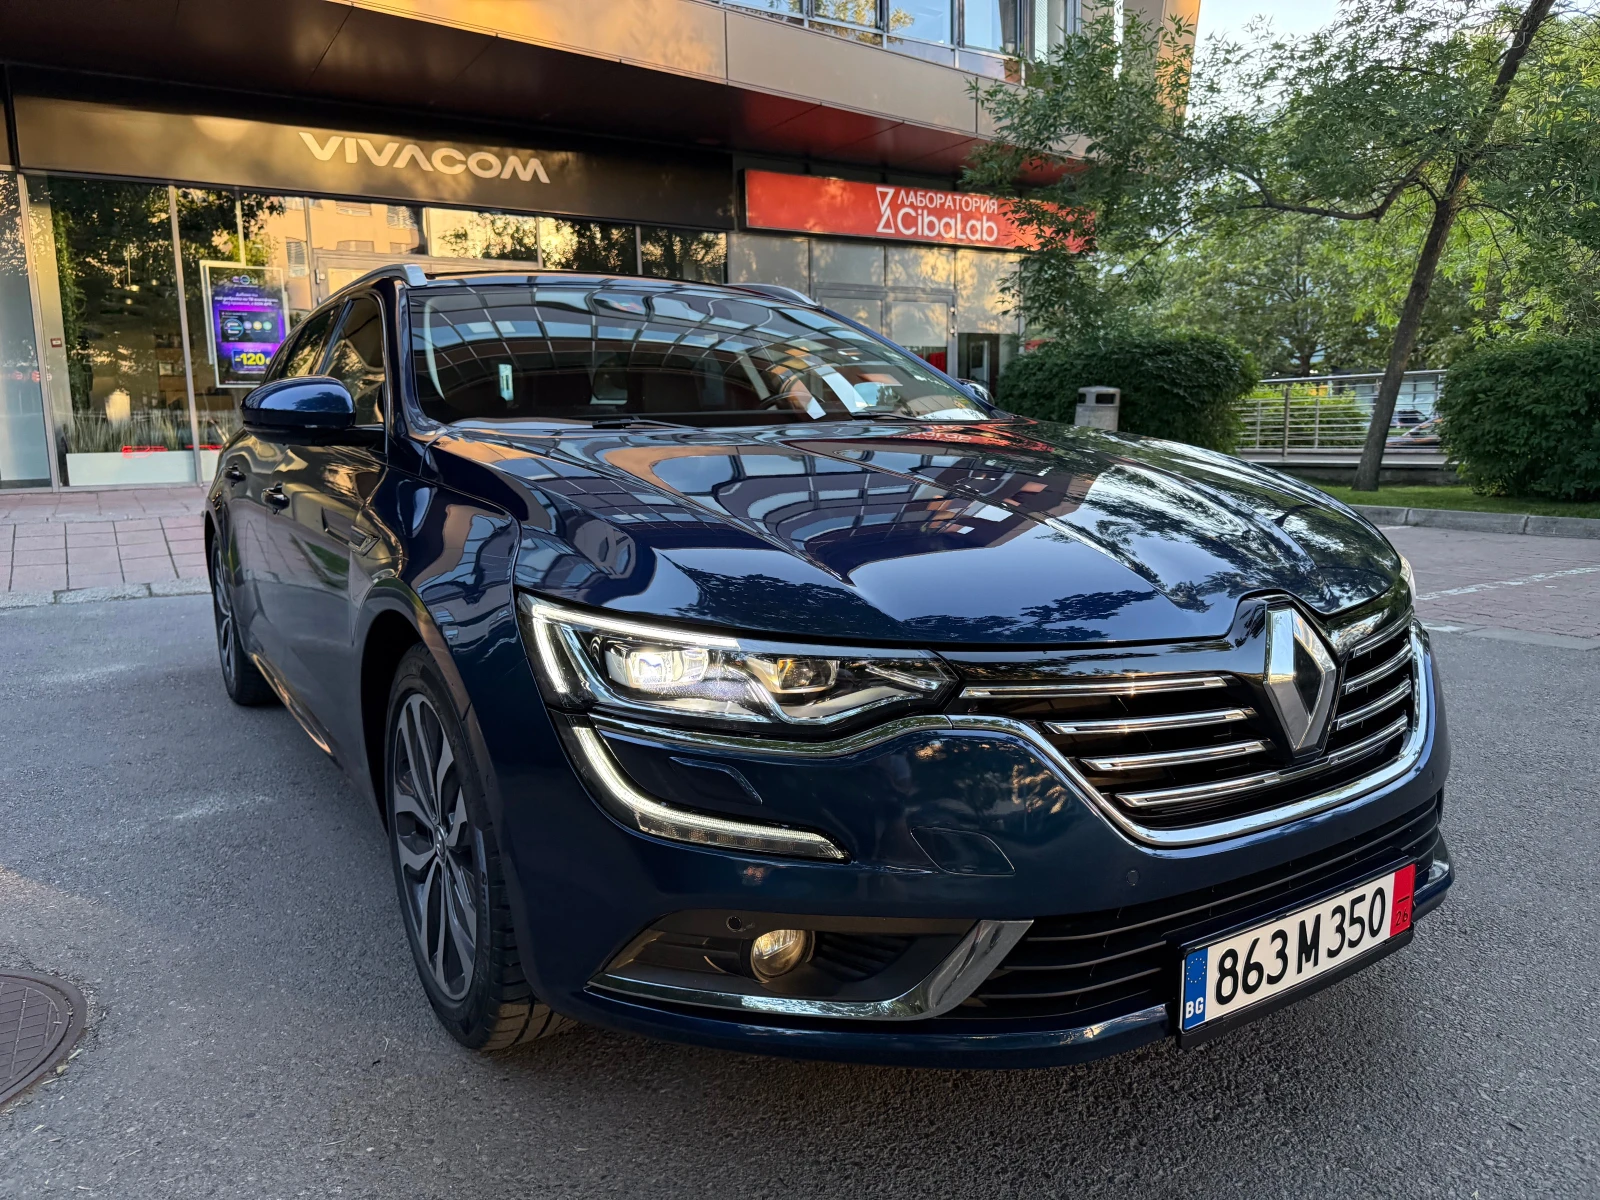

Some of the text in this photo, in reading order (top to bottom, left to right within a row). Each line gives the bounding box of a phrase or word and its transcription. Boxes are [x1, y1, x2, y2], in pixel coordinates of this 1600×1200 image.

[299, 132, 550, 184] VIVACOM
[897, 190, 998, 214] ЛАБОРАТОРИЯ
[897, 207, 998, 242] CibaLab
[1395, 908, 1409, 927] 26
[1215, 929, 1288, 1006] 863
[1327, 886, 1386, 958] 350
[1185, 996, 1205, 1020] BG
